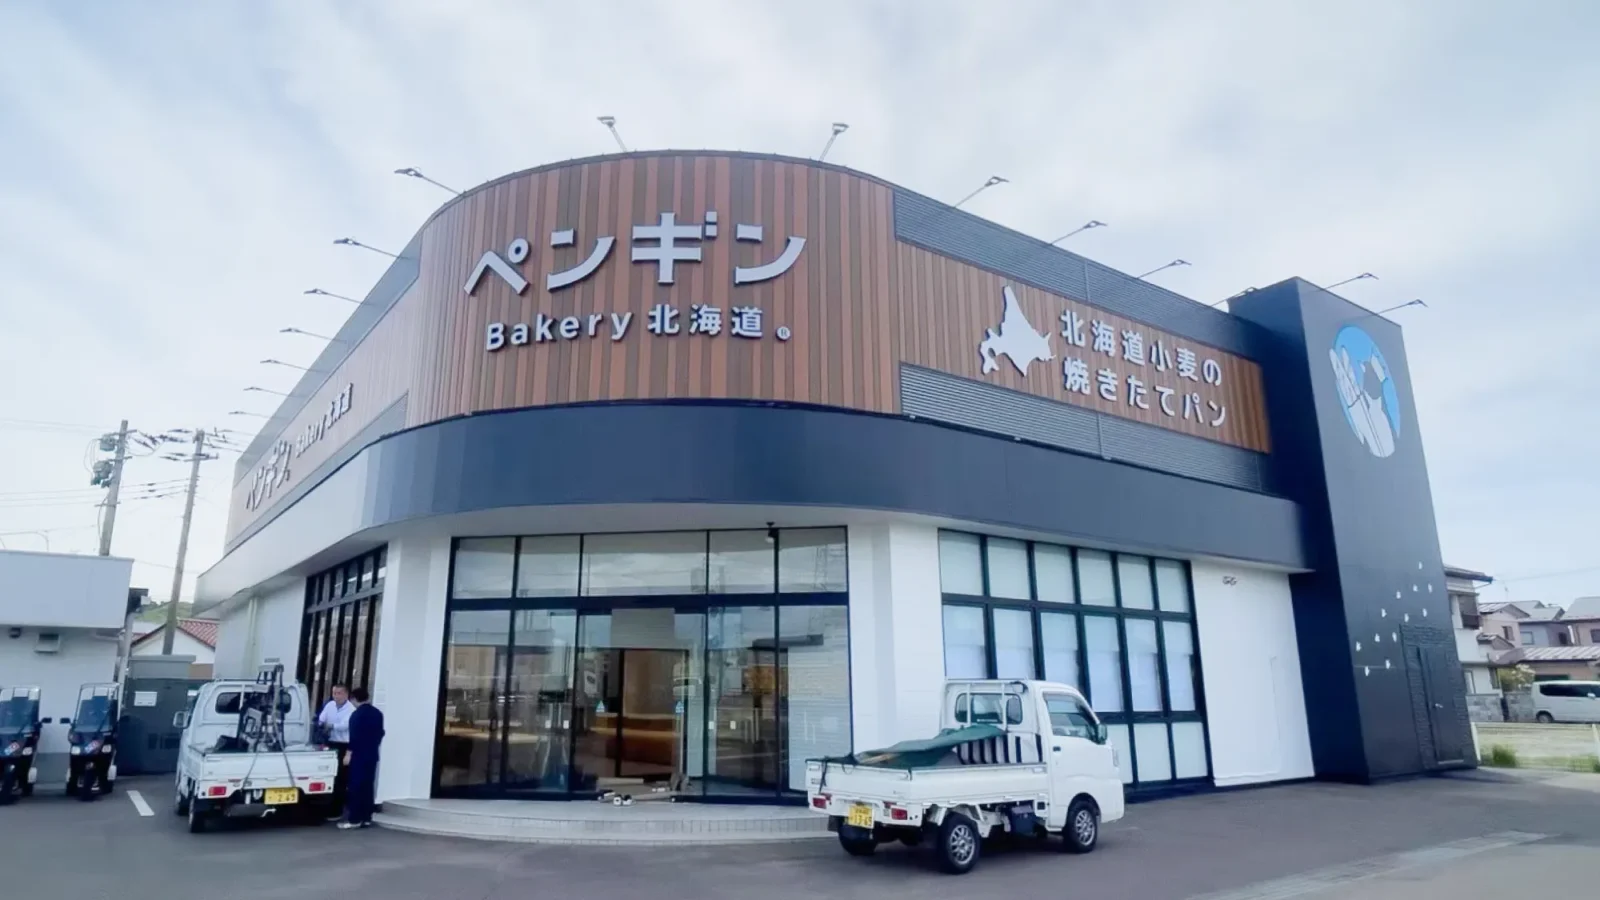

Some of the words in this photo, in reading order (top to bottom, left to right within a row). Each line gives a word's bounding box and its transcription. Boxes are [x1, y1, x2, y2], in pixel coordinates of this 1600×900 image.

[464, 211, 806, 295] ペンギン
[486, 312, 632, 351] Bakery
[647, 303, 763, 340] 北海道
[1060, 309, 1222, 387] 北海道小麦の
[1063, 356, 1226, 427] 焼きたてパン
